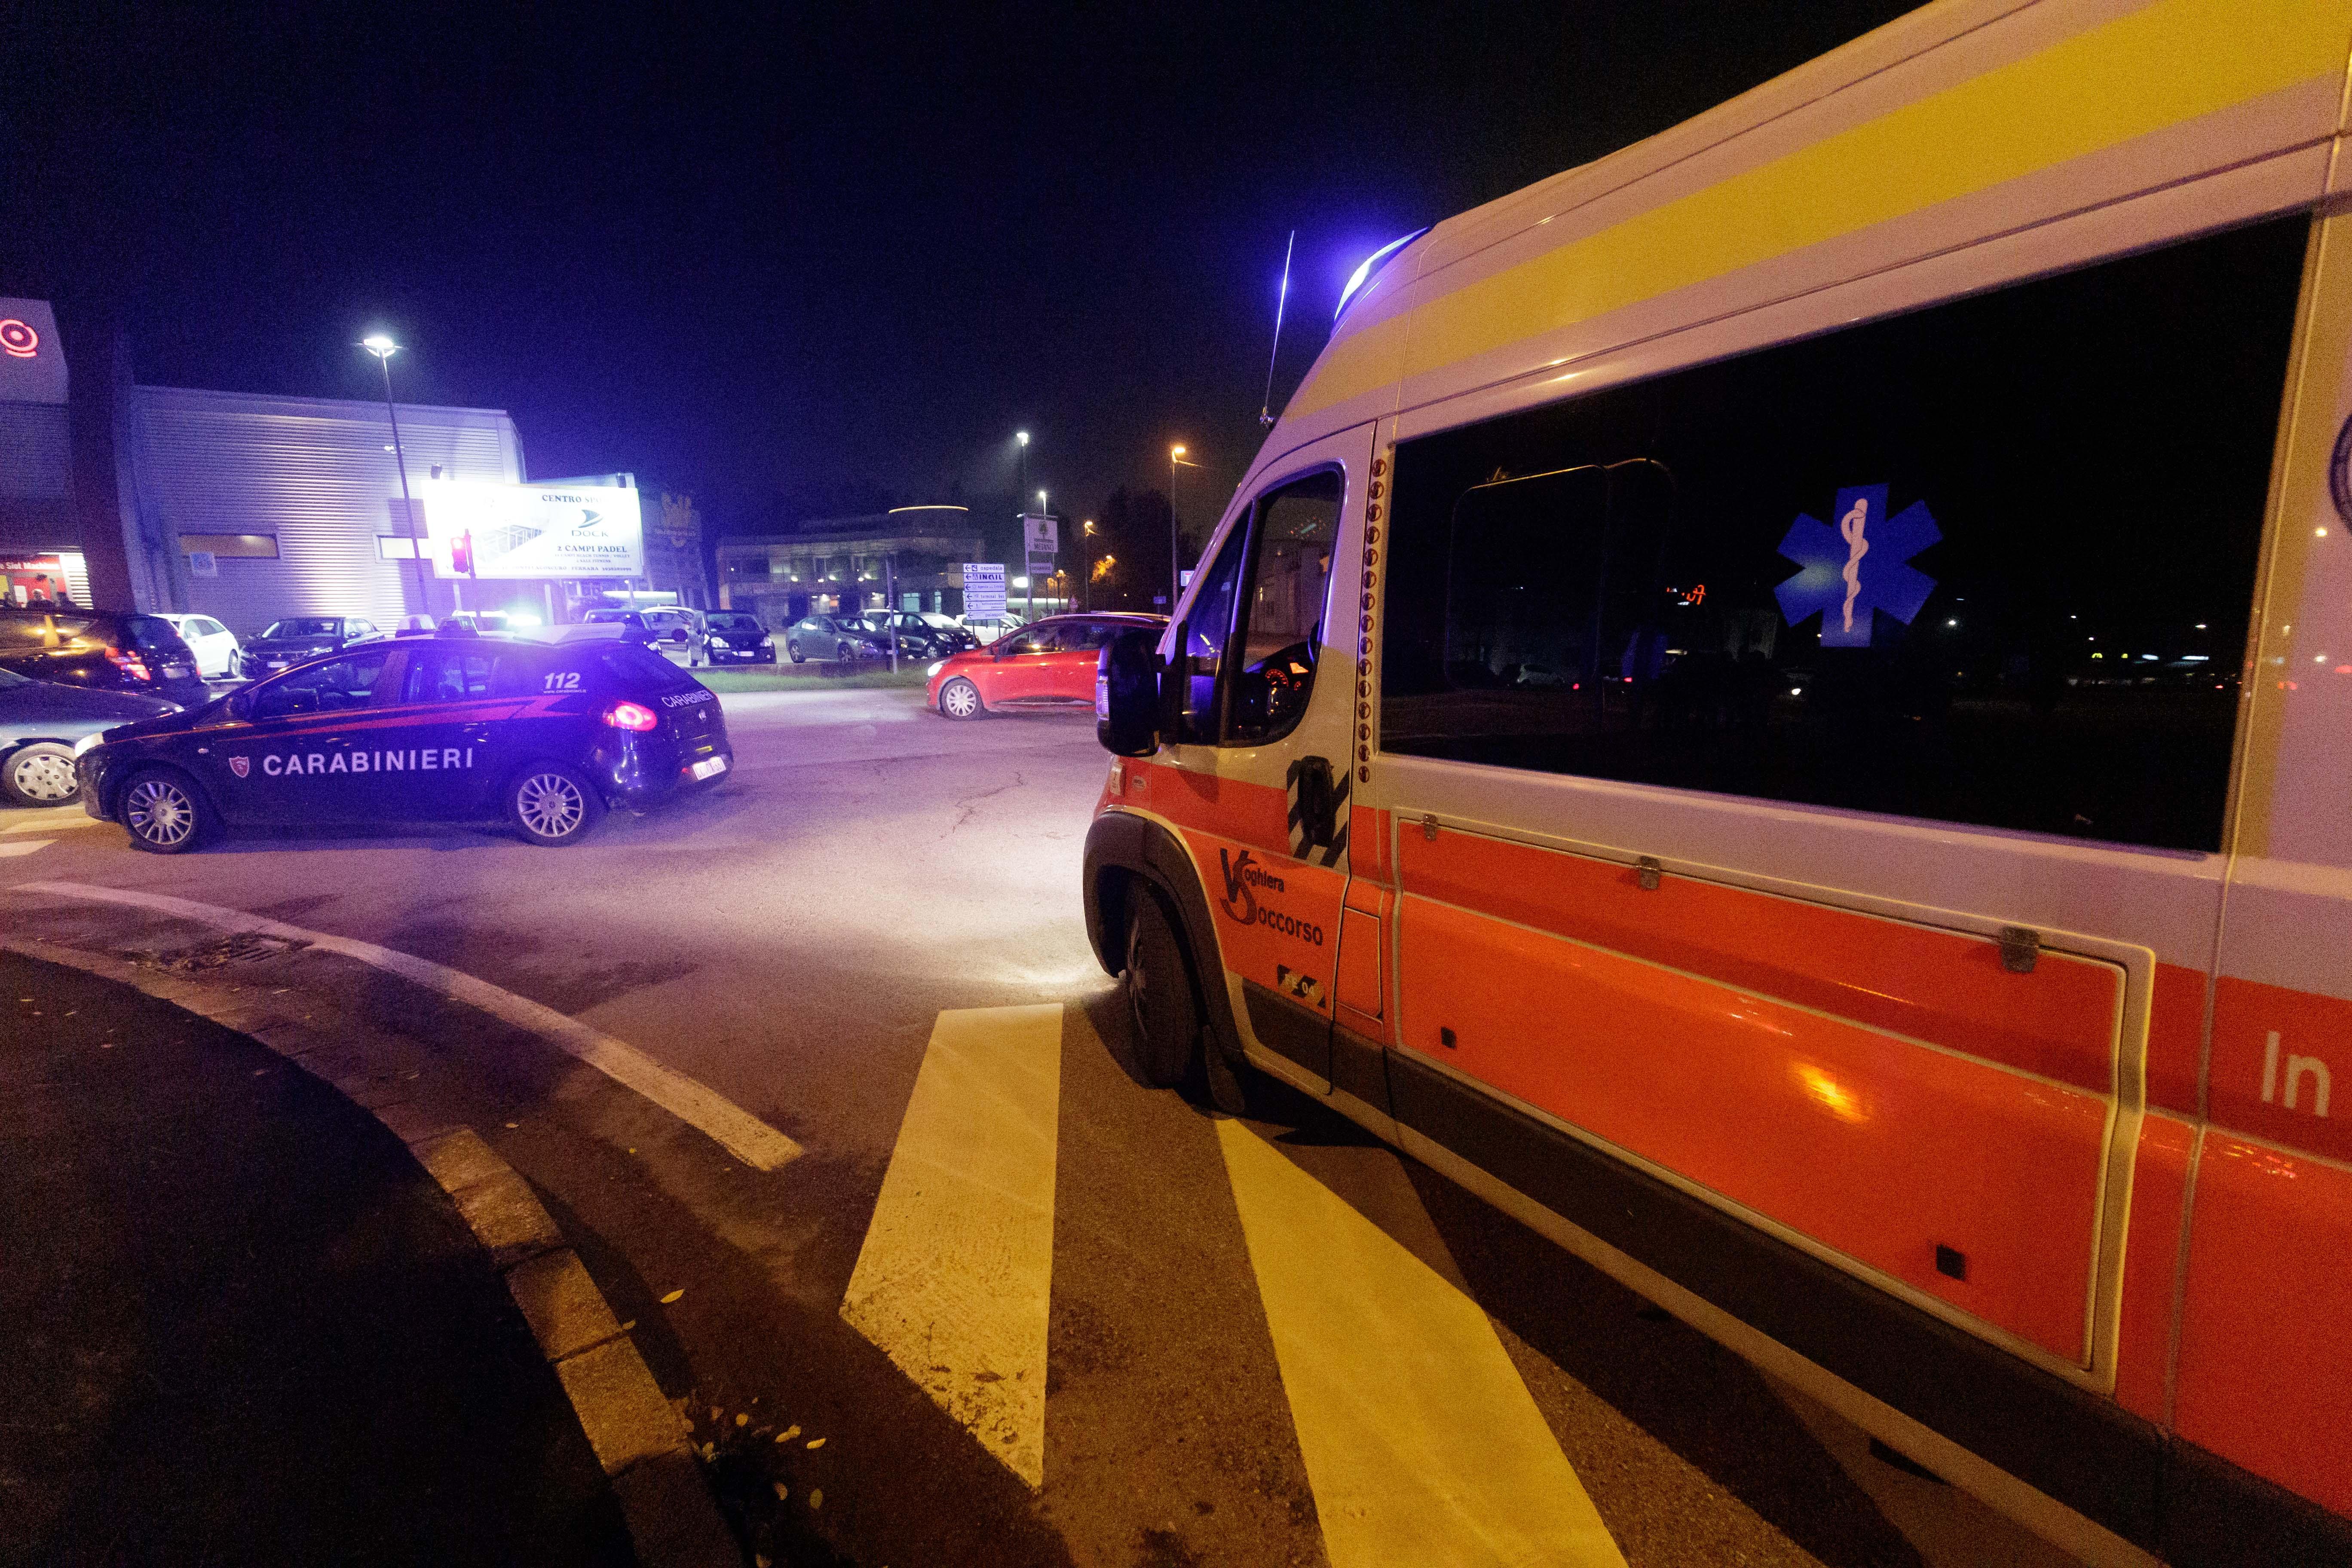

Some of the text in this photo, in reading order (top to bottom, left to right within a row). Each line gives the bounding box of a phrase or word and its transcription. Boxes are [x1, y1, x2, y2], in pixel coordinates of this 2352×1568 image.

[1035, 542, 1054, 551] METANO
[545, 672, 580, 689] 112
[263, 747, 473, 776] CARABINIERI
[2262, 1031, 2331, 1118] In
